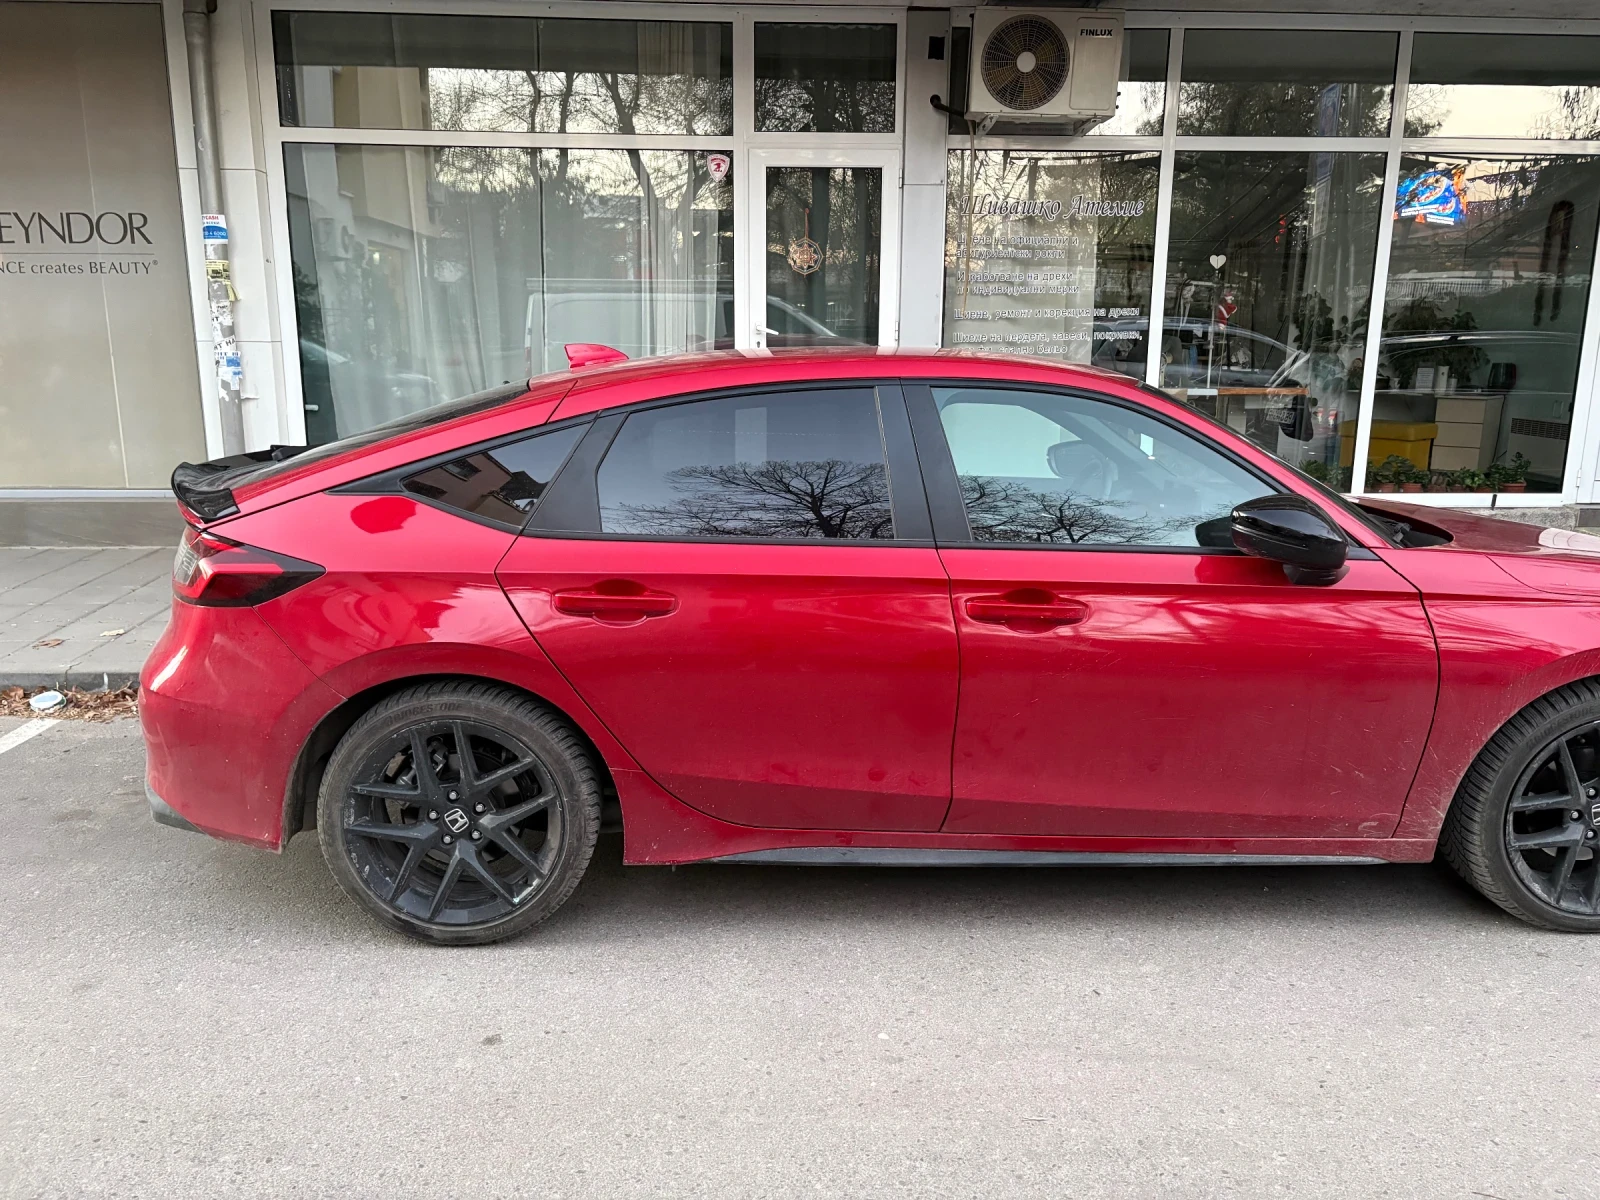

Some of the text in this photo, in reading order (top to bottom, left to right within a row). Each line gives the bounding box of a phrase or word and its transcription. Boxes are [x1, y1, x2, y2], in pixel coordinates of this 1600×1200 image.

[1080, 28, 1113, 37] FINLUX
[961, 193, 1144, 221] Шивашко Ателие
[957, 233, 991, 246] Шене
[31, 262, 84, 275] creates
[957, 271, 1073, 284] Иработване на дрехи
[1048, 285, 1080, 296] мерки
[995, 309, 1031, 320] ремонт
[1035, 309, 1041, 319] и
[1044, 308, 1091, 320] корекция
[1094, 307, 1105, 318] на
[1108, 307, 1140, 318] дрехи
[953, 332, 988, 343] Шиене
[990, 333, 1002, 343] на
[1005, 331, 1050, 344] пердета,
[1052, 331, 1091, 343] завеси,
